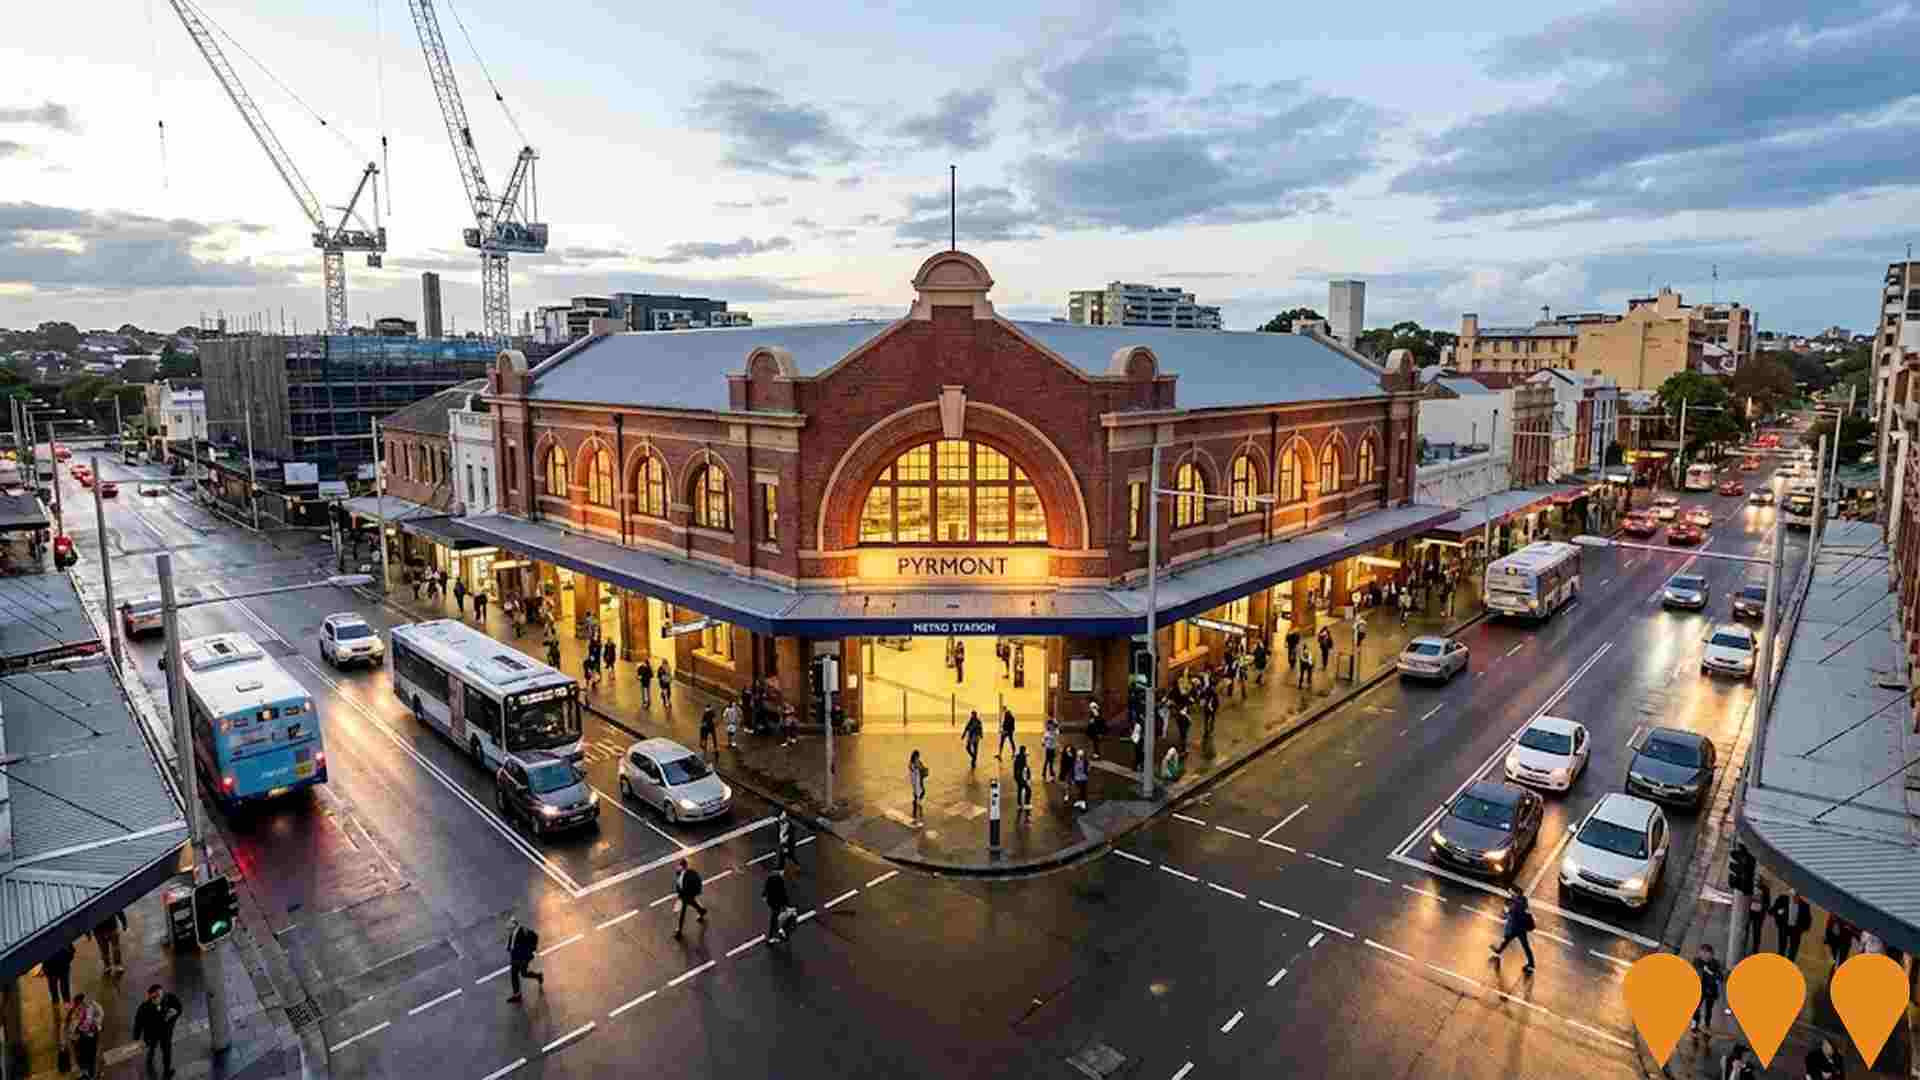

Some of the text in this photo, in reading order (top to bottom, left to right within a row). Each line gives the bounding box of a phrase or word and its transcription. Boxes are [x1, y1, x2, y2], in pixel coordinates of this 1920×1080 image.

[898, 557, 1008, 576] PYRMONT
[913, 623, 996, 633] METRO STATION
